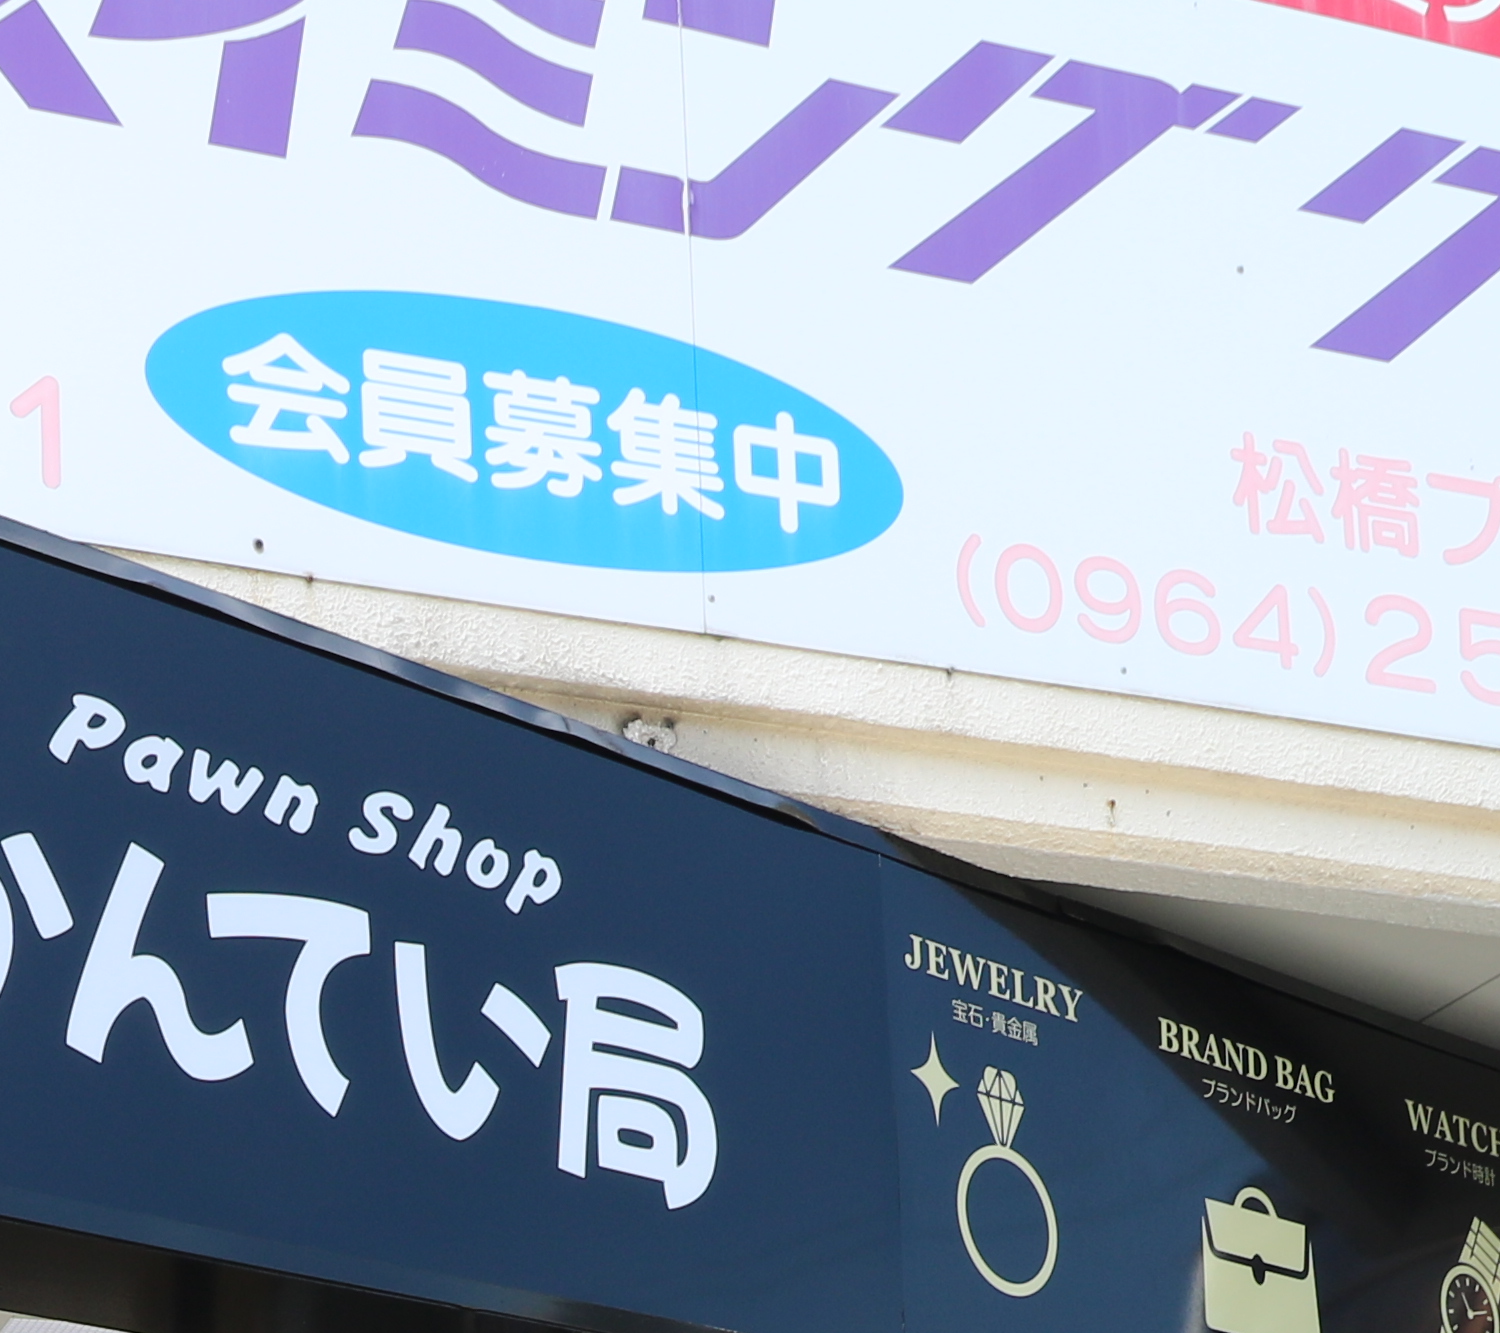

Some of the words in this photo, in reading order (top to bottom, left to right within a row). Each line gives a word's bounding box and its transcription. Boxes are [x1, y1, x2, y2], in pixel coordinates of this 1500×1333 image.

[221, 330, 842, 535] 会員募集中
[48, 692, 319, 834] Pawn
[347, 789, 563, 916] Shop
[904, 932, 1083, 1022] JEWELRY
[1156, 1016, 1268, 1084] BRAND
[1275, 1055, 1336, 1104] BAG
[1201, 1077, 1298, 1125] ブランドバッグ
[1424, 1147, 1496, 1189] ブランド時計
